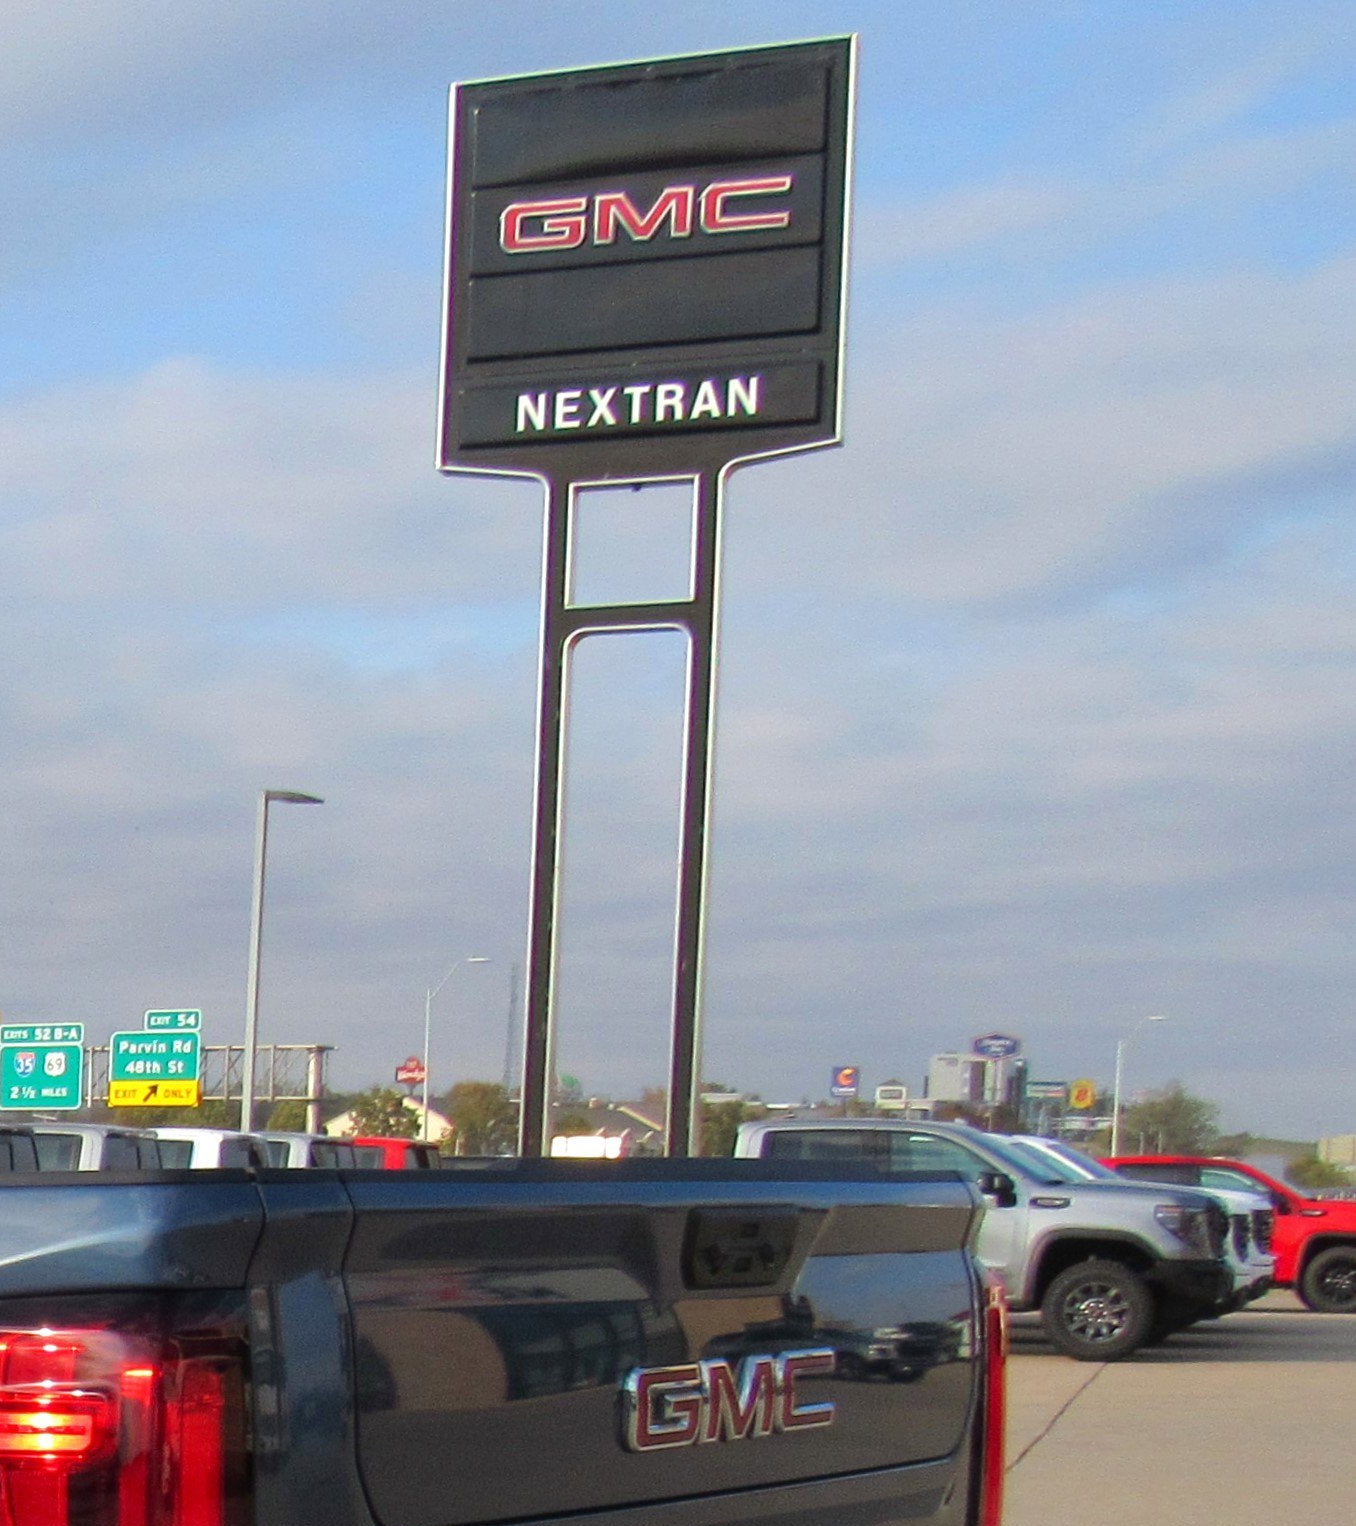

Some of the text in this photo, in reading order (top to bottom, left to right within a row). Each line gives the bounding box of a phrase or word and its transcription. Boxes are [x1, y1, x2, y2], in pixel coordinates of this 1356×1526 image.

[499, 174, 792, 254] GMC
[516, 374, 761, 433] NEXTRAN
[150, 1013, 196, 1026] EXIT 54
[34, 1028, 51, 1040] 52
[119, 1040, 192, 1054] Parvin Rd
[17, 1059, 33, 1072] 35
[47, 1058, 62, 1071] 69
[125, 1060, 184, 1074] 48th St
[41, 1087, 67, 1097] MILES
[114, 1088, 192, 1099] EXIT ONLY
[622, 1347, 836, 1451] GMC
